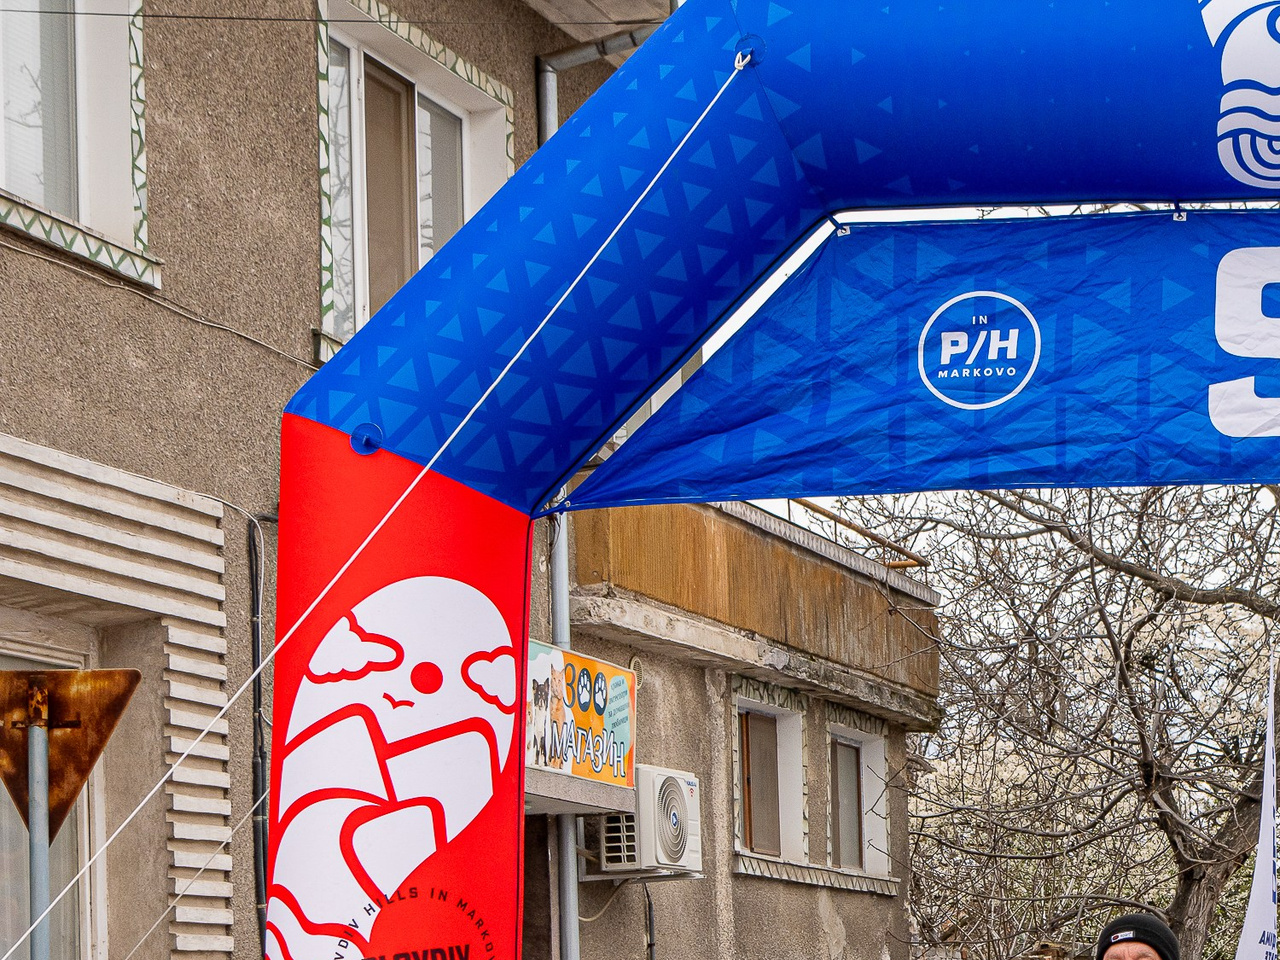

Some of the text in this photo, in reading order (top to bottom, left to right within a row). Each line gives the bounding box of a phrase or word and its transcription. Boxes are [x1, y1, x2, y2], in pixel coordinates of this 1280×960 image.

[972, 315, 988, 325] IN
[941, 328, 1019, 365] P/H
[938, 367, 1017, 378] MARKOVO
[551, 719, 626, 778] МАГАЗИН
[364, 887, 418, 916] HILLS
[430, 887, 448, 901] IN
